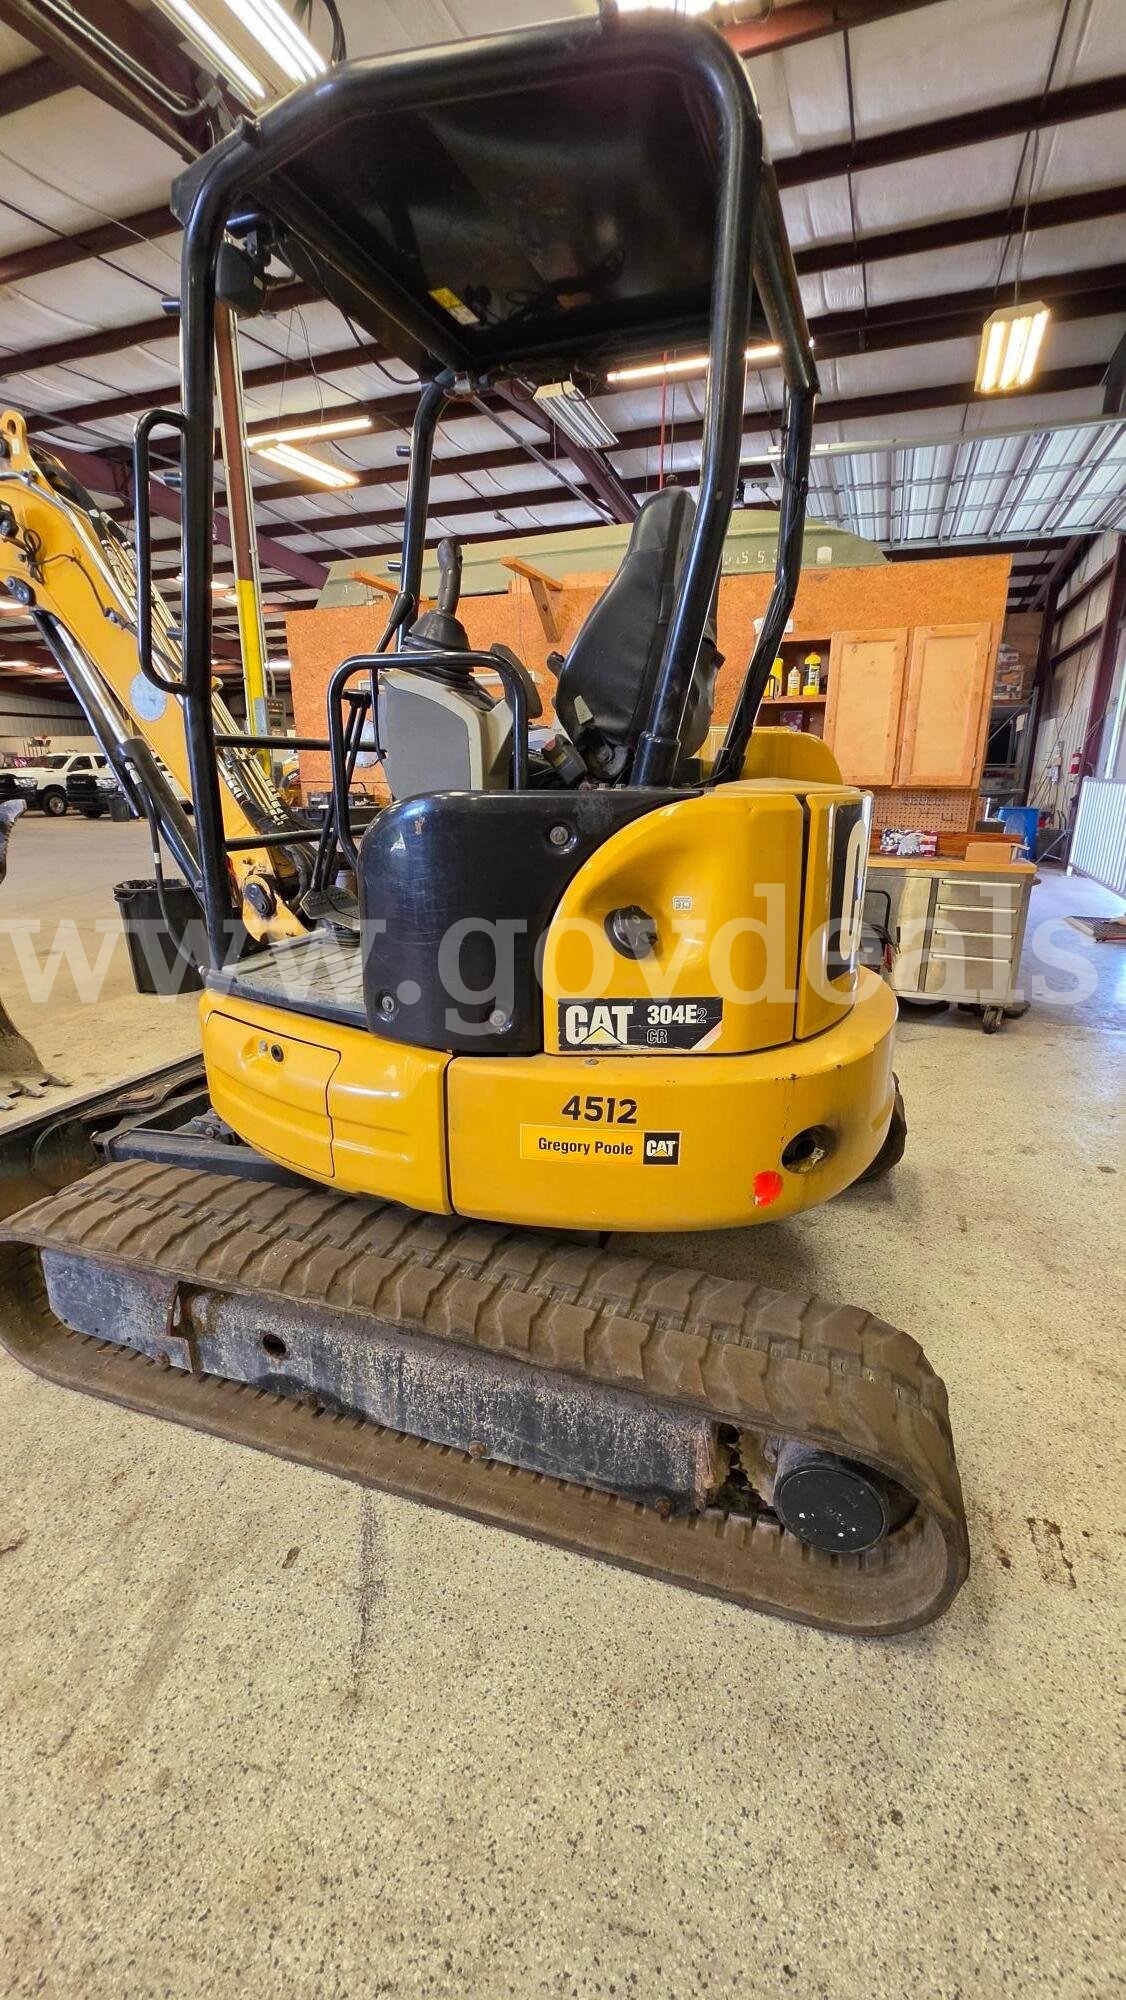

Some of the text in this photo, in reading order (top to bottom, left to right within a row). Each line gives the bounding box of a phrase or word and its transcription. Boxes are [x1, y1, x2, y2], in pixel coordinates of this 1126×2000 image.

[565, 1005, 634, 1045] CAT
[646, 1028, 668, 1044] CR
[562, 1095, 638, 1124] 4512
[538, 1137, 679, 1158] Gregory Poole CAT
